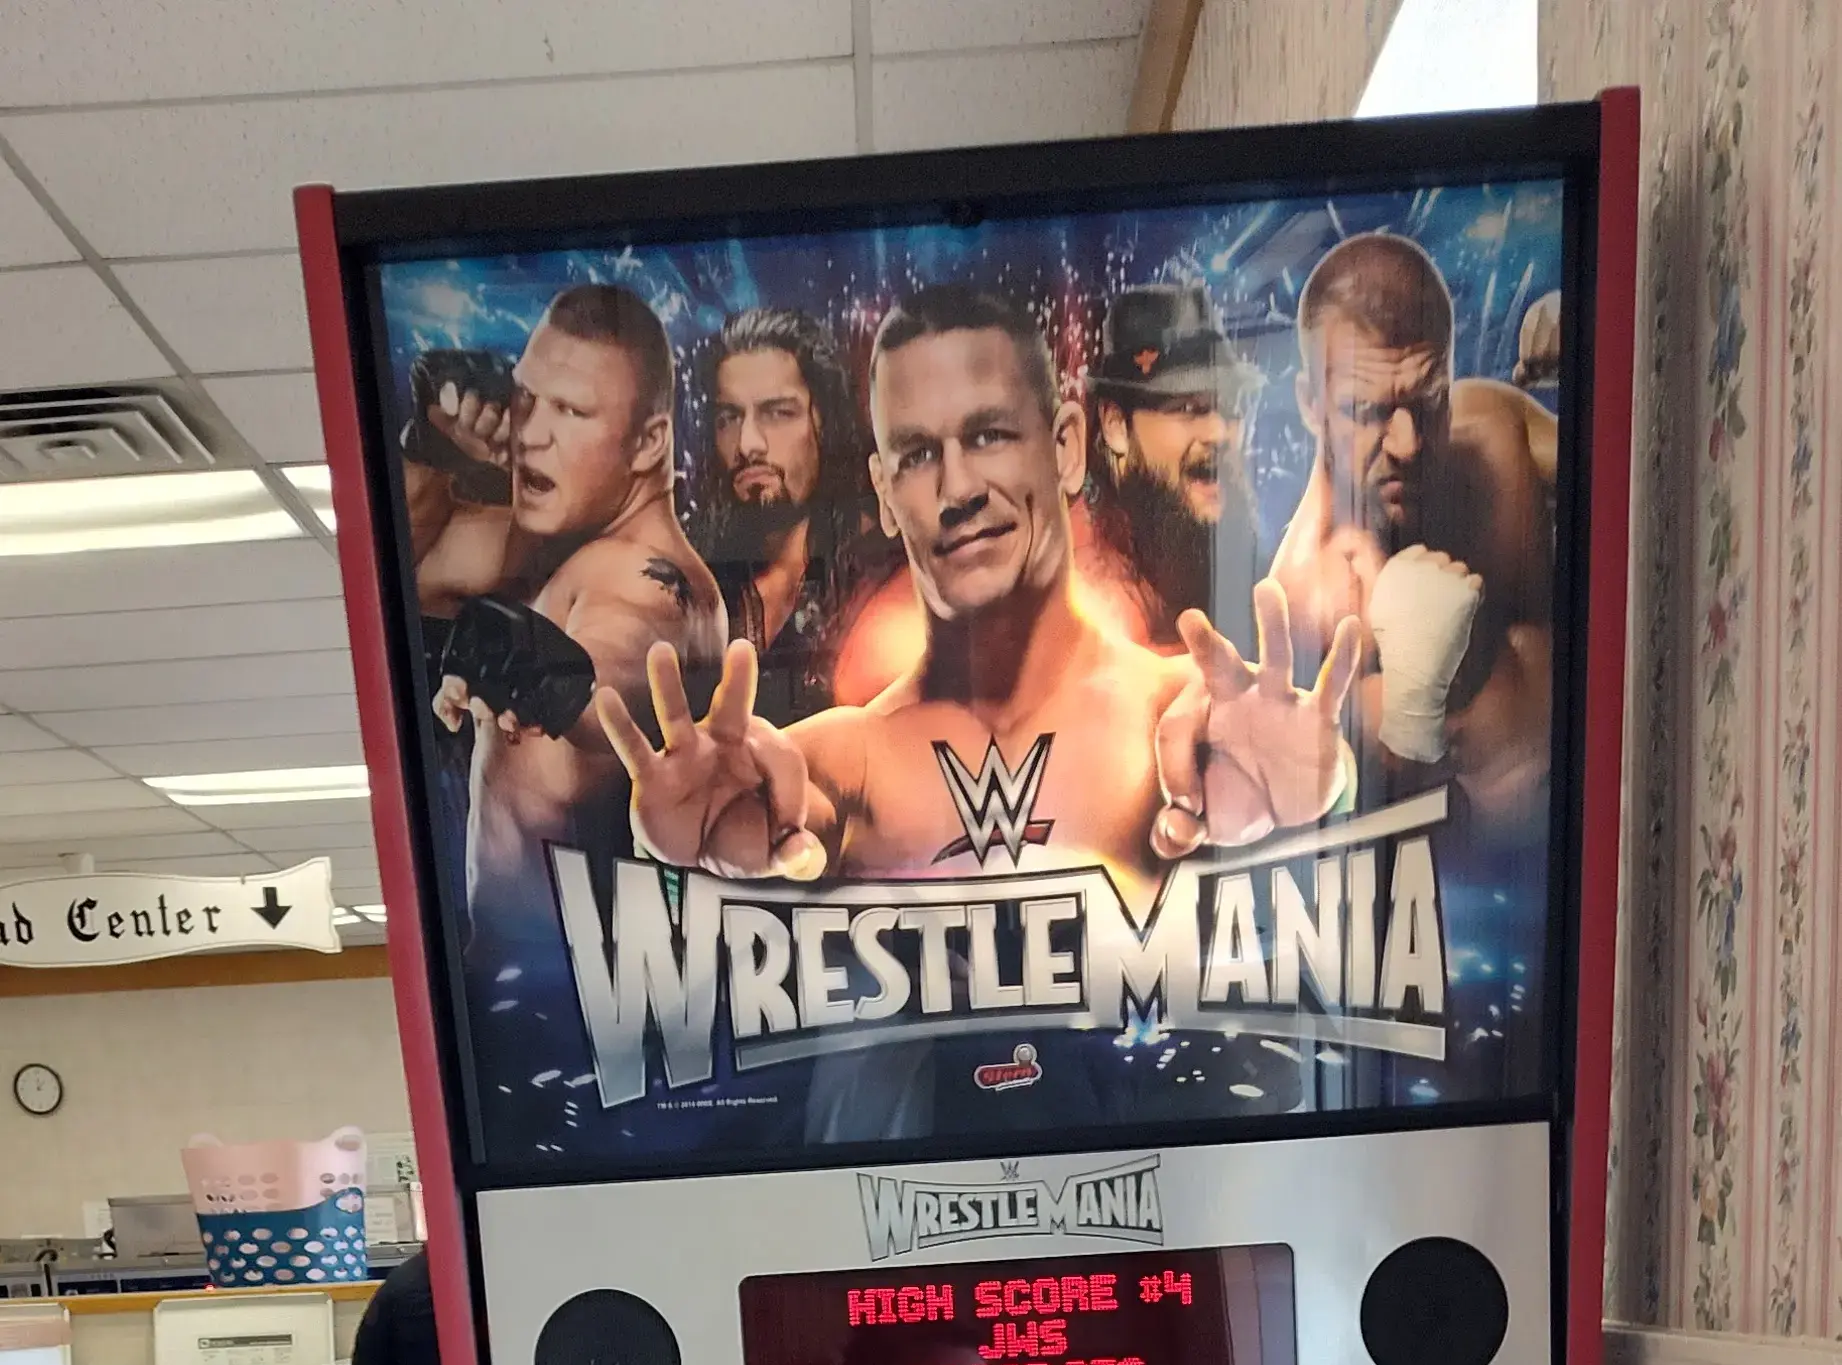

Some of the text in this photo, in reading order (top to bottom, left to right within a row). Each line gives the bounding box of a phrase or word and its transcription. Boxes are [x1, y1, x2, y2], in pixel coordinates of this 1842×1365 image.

[67, 893, 222, 942] Center
[847, 1270, 1192, 1326] HIGH SCORE #4
[977, 1319, 1068, 1360] JWS
